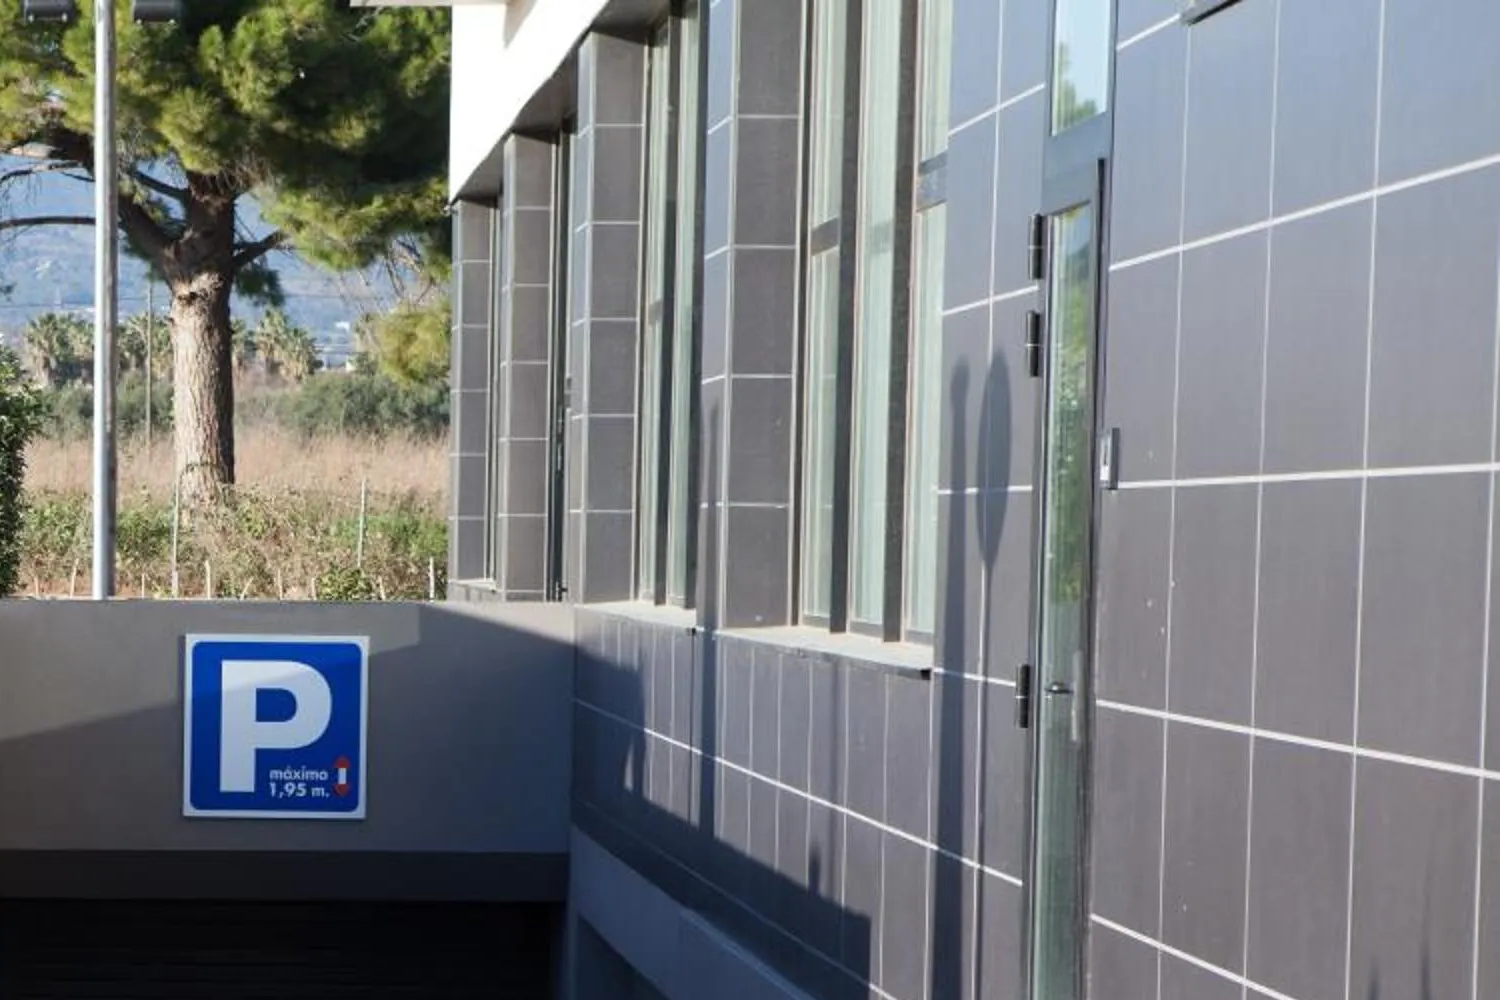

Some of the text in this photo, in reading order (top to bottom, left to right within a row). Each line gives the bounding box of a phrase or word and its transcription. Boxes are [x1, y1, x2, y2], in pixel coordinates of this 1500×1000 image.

[220, 660, 332, 792] P
[269, 765, 329, 780] máximo
[269, 782, 330, 798] 1,95 m.
